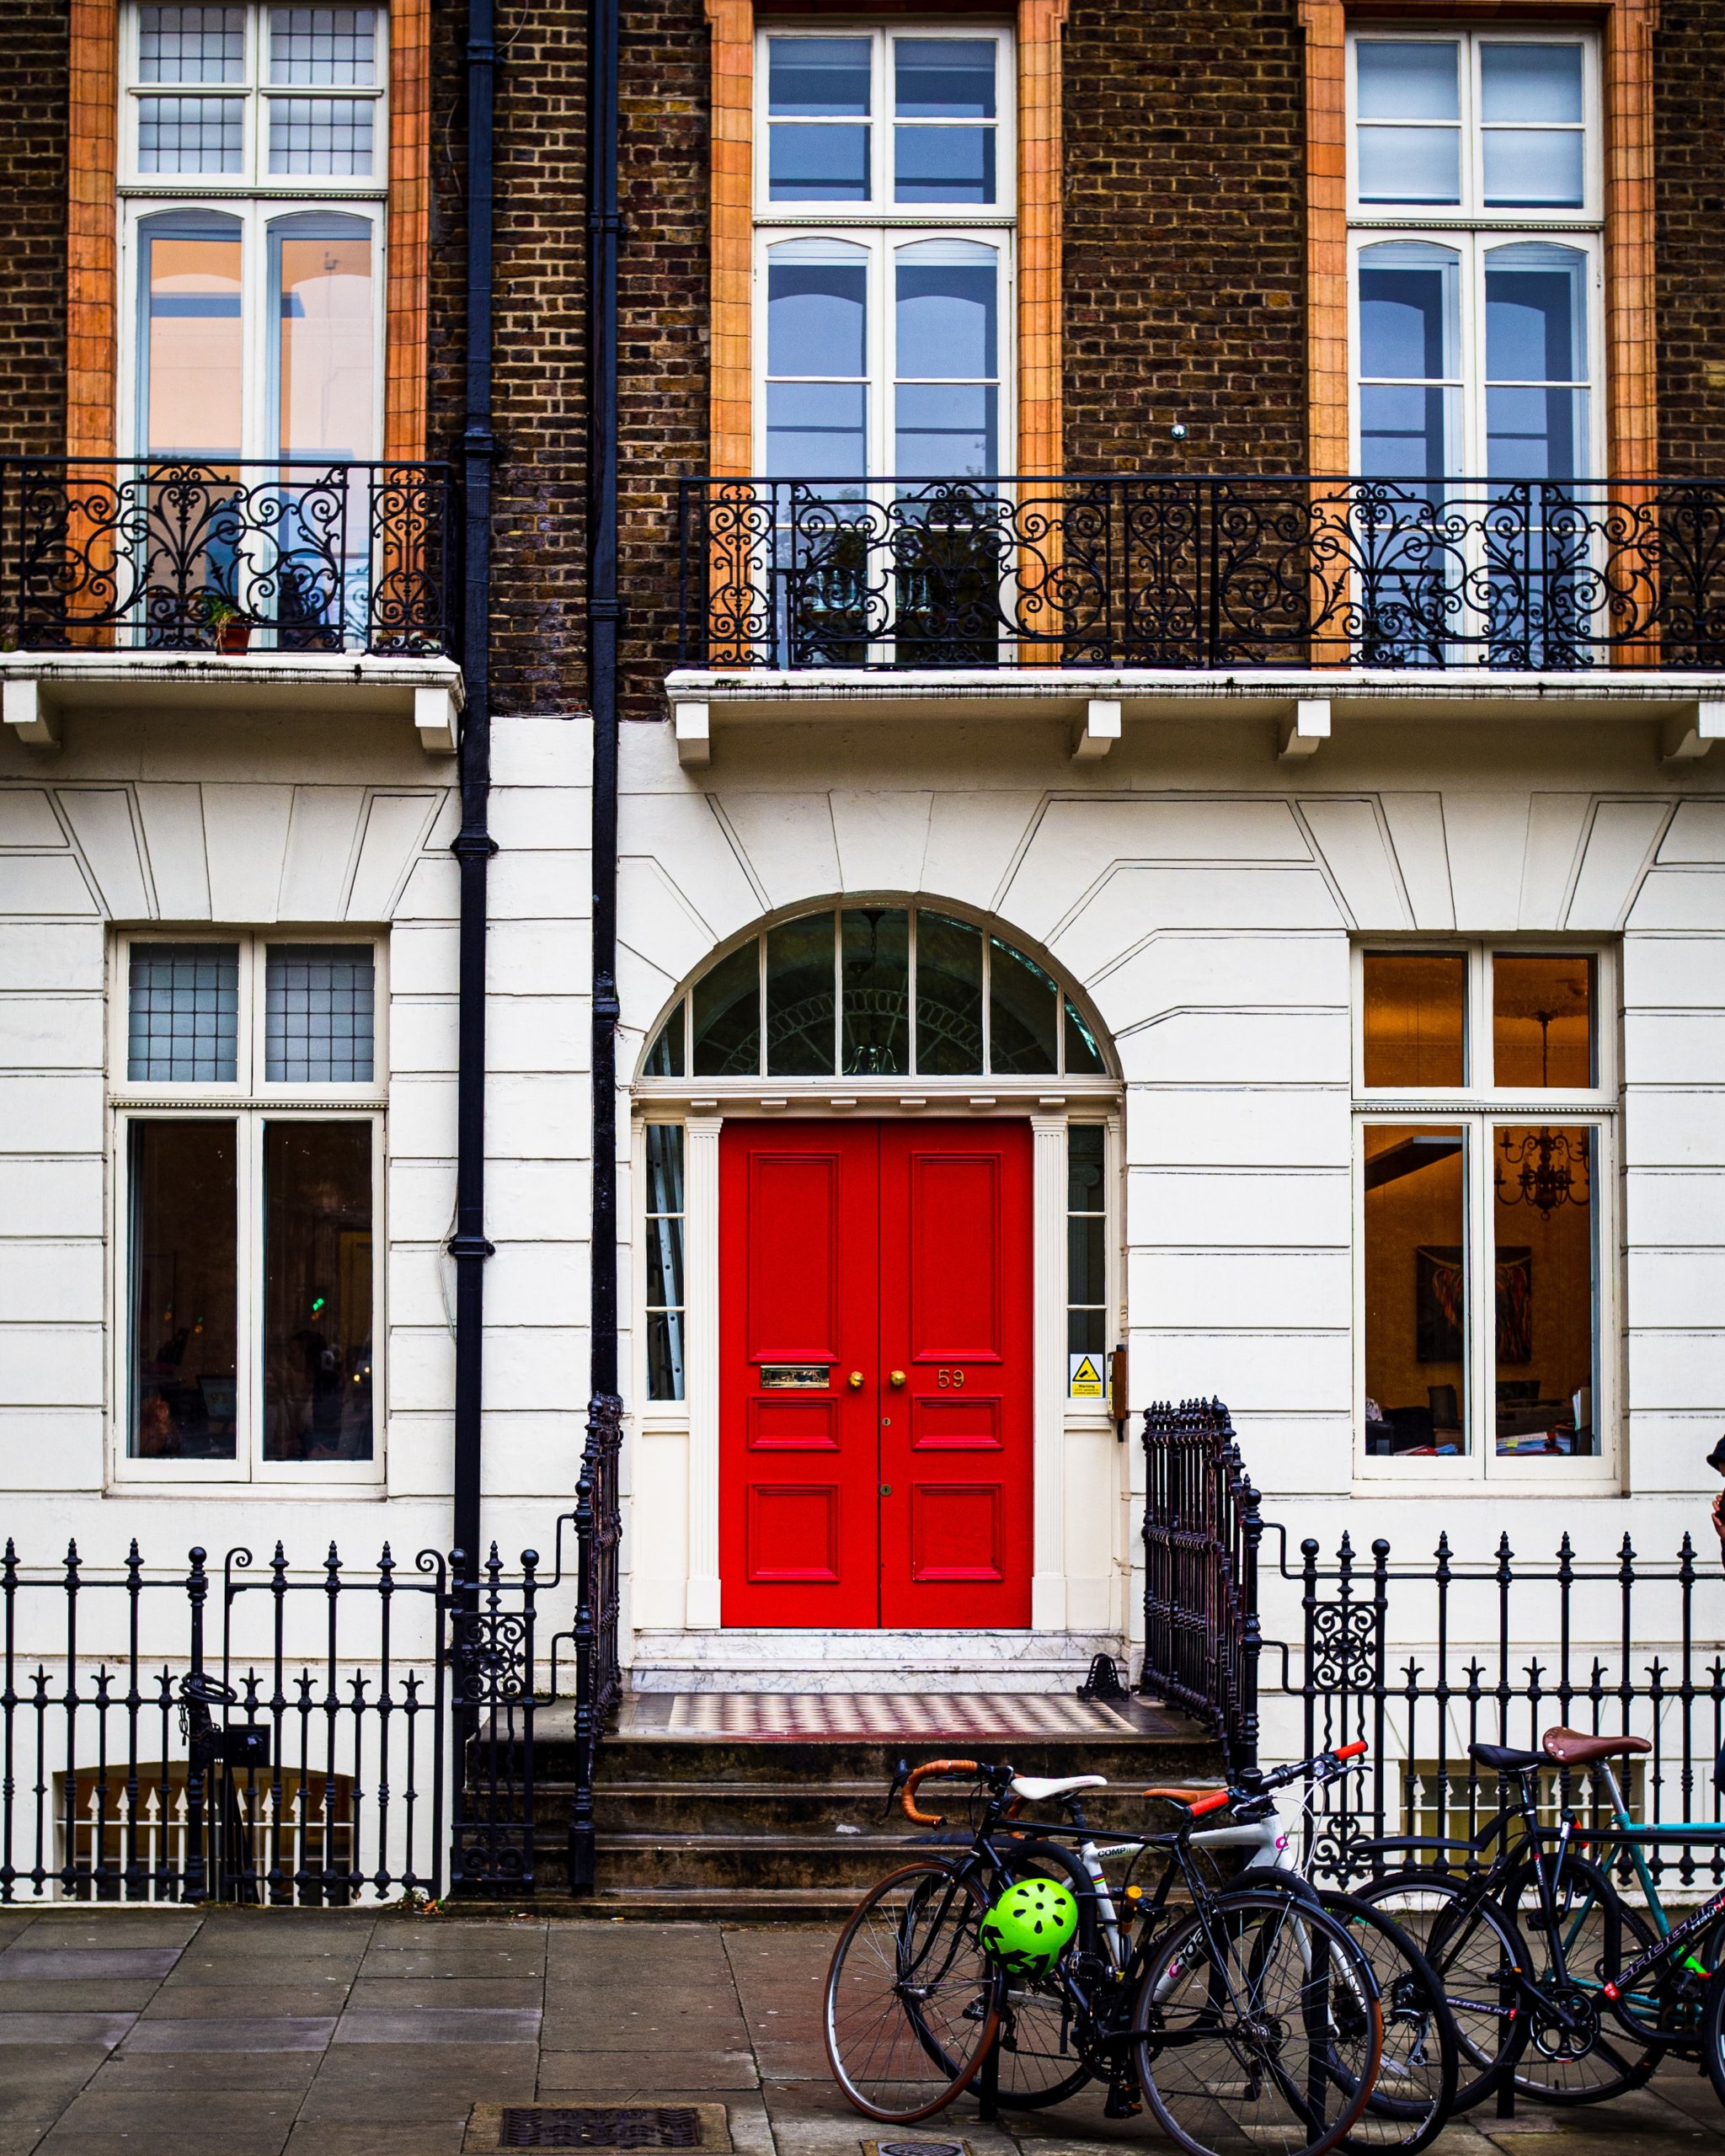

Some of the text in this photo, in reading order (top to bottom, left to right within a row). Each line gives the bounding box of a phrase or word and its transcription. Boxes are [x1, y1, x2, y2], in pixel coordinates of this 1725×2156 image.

[937, 1369, 964, 1388] 59
[1097, 1847, 1125, 1857] COMP
[1614, 1892, 1723, 1988] SHOGUN
[1445, 1998, 1509, 2015] SHOGUN
